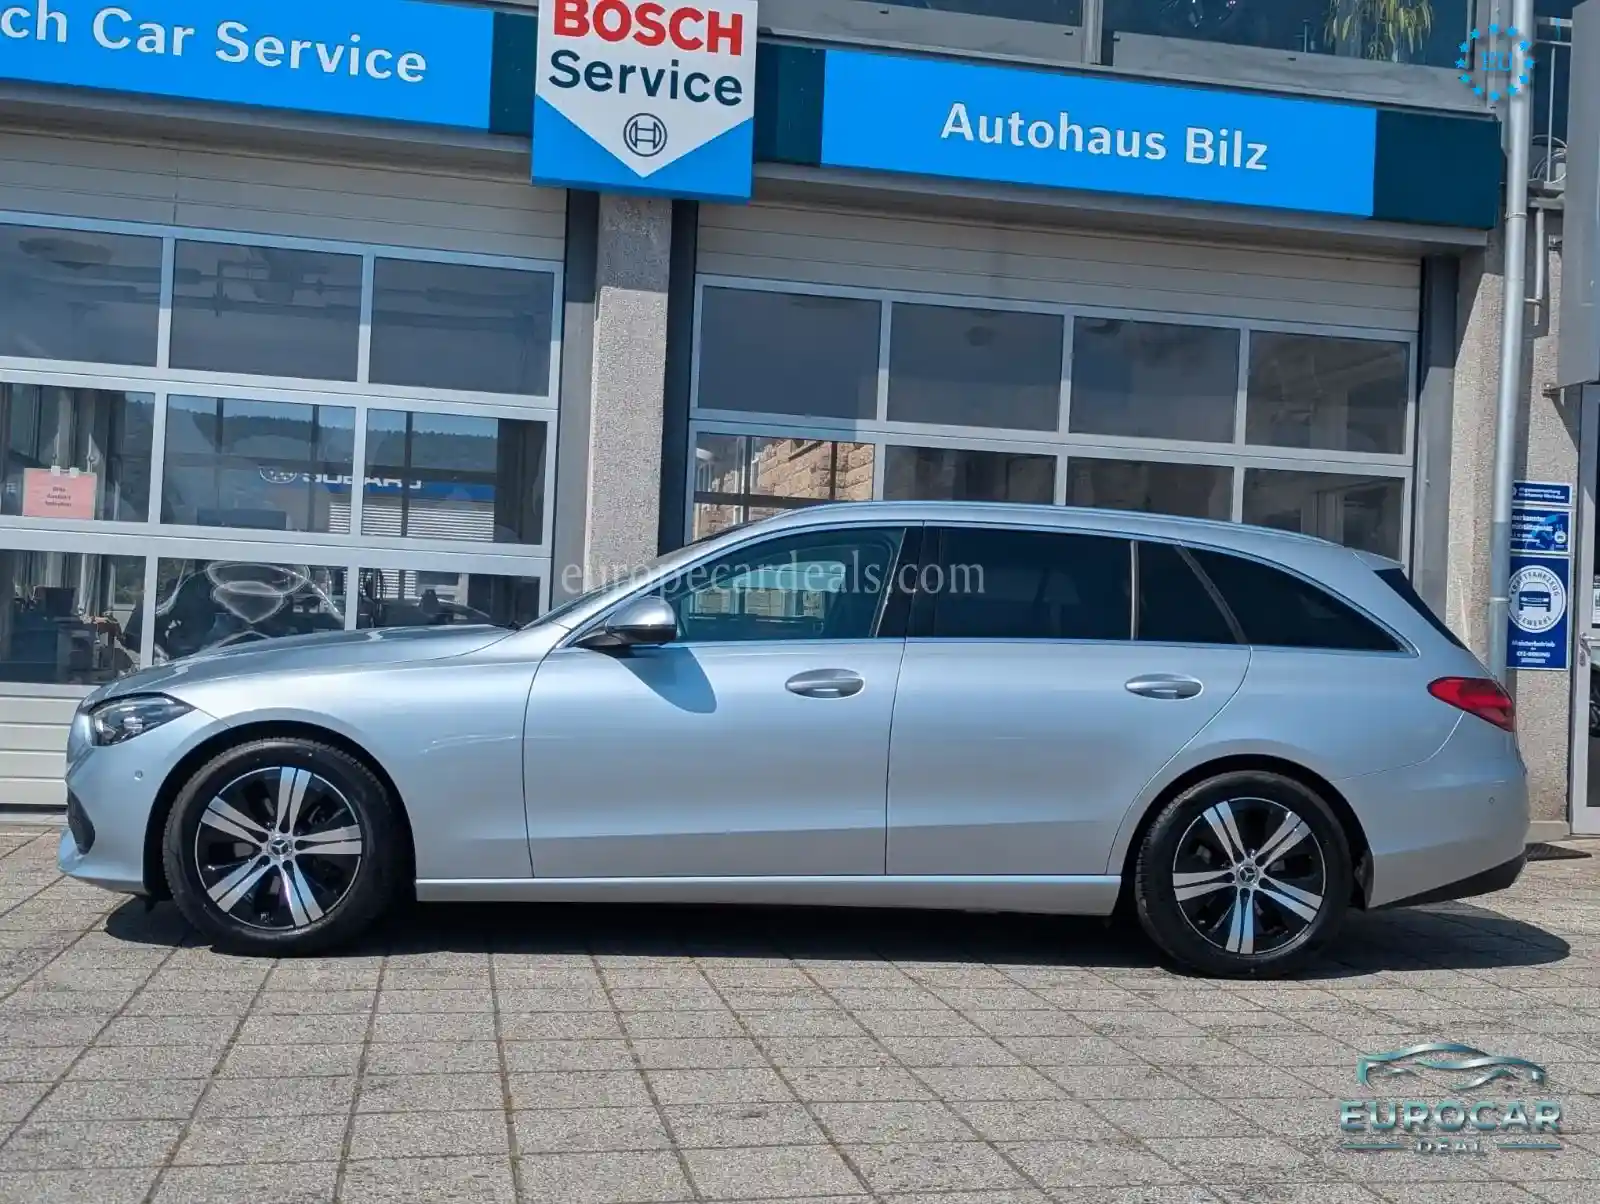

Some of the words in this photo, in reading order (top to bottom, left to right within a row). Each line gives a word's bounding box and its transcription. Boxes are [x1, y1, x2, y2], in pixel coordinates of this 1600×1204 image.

[92, 7, 195, 56] Car
[215, 20, 428, 83] Service
[553, 0, 743, 56] BOSCH
[548, 49, 743, 107] Service
[940, 102, 1168, 160] Autohaus
[1184, 126, 1268, 171] Bilz
